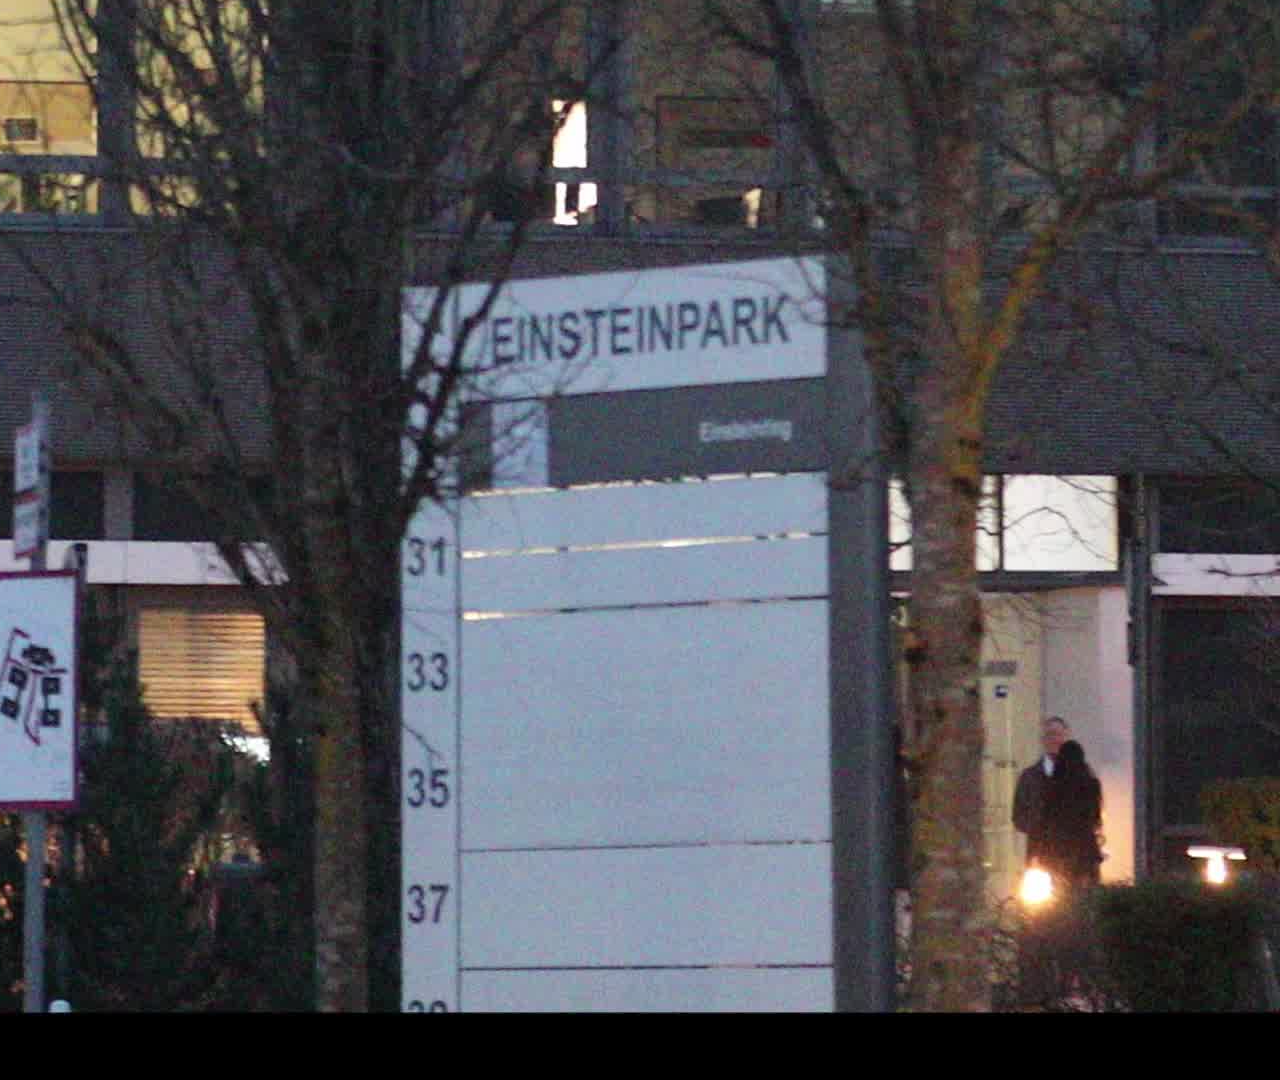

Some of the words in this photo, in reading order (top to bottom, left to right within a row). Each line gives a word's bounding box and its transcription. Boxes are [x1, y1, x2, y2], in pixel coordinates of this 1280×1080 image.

[492, 293, 789, 366] EINSTEINPARK
[407, 536, 447, 576] 31
[406, 652, 449, 692] 33
[406, 768, 449, 809] 35
[406, 884, 449, 924] 37
